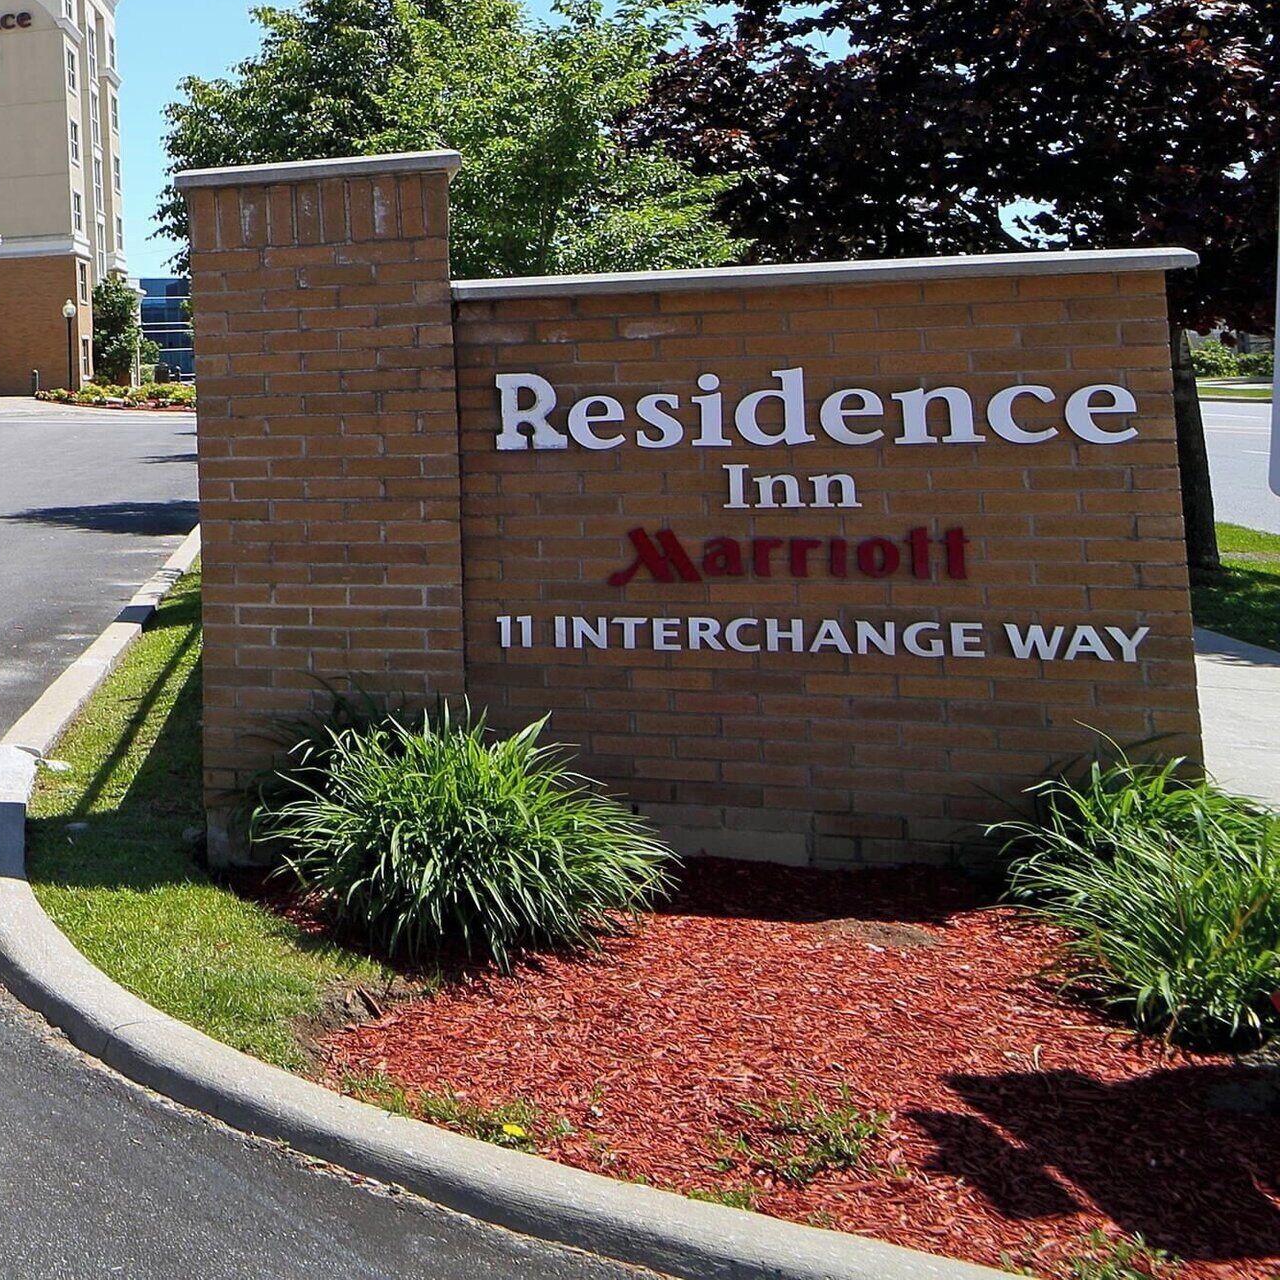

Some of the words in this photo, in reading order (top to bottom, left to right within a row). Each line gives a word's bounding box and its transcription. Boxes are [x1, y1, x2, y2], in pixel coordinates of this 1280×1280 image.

[494, 366, 1140, 451] Residence
[722, 463, 863, 509] Inn
[606, 526, 971, 587] Marriott
[496, 615, 533, 649] 11
[554, 615, 987, 658] INTERCHANGE
[1002, 622, 1151, 663] WAY
